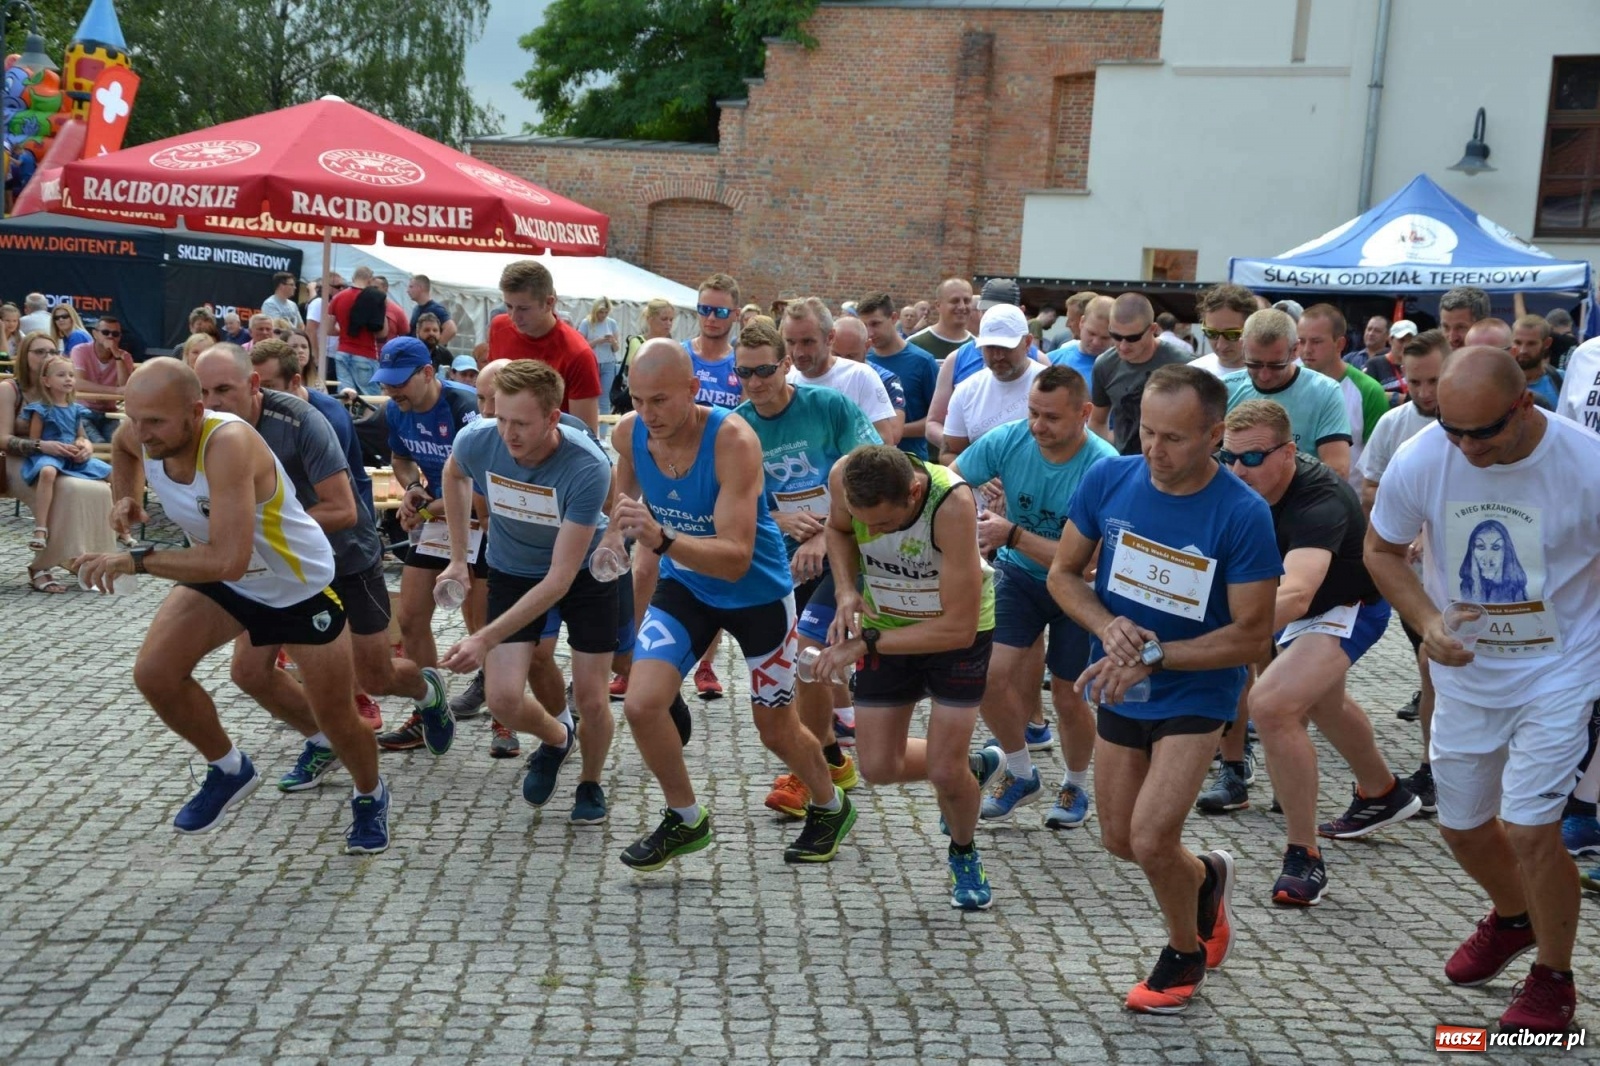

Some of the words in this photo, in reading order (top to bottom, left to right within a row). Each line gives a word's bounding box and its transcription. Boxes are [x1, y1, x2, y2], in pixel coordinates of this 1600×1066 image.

[83, 176, 240, 209] RACIBORSKIE
[291, 190, 473, 230] RACIBORSKIE
[513, 213, 600, 246] RACIBORSKIE
[0, 235, 138, 256] WWW.DIGITENT.PL
[177, 244, 212, 261] SKLEP
[213, 248, 291, 271] INTERNETOWY
[1264, 266, 1330, 286] ŚLĄSKI
[1338, 270, 1422, 285] ODDZIAŁ
[1429, 269, 1541, 285] TERENOWY
[46, 294, 112, 311] DIGITENT
[519, 495, 527, 506] 3
[1460, 505, 1479, 516] BIEG
[1480, 503, 1534, 524] KRZANOWICKI
[1146, 564, 1171, 585] 36
[898, 595, 919, 607] 31
[1490, 622, 1514, 636] 44
